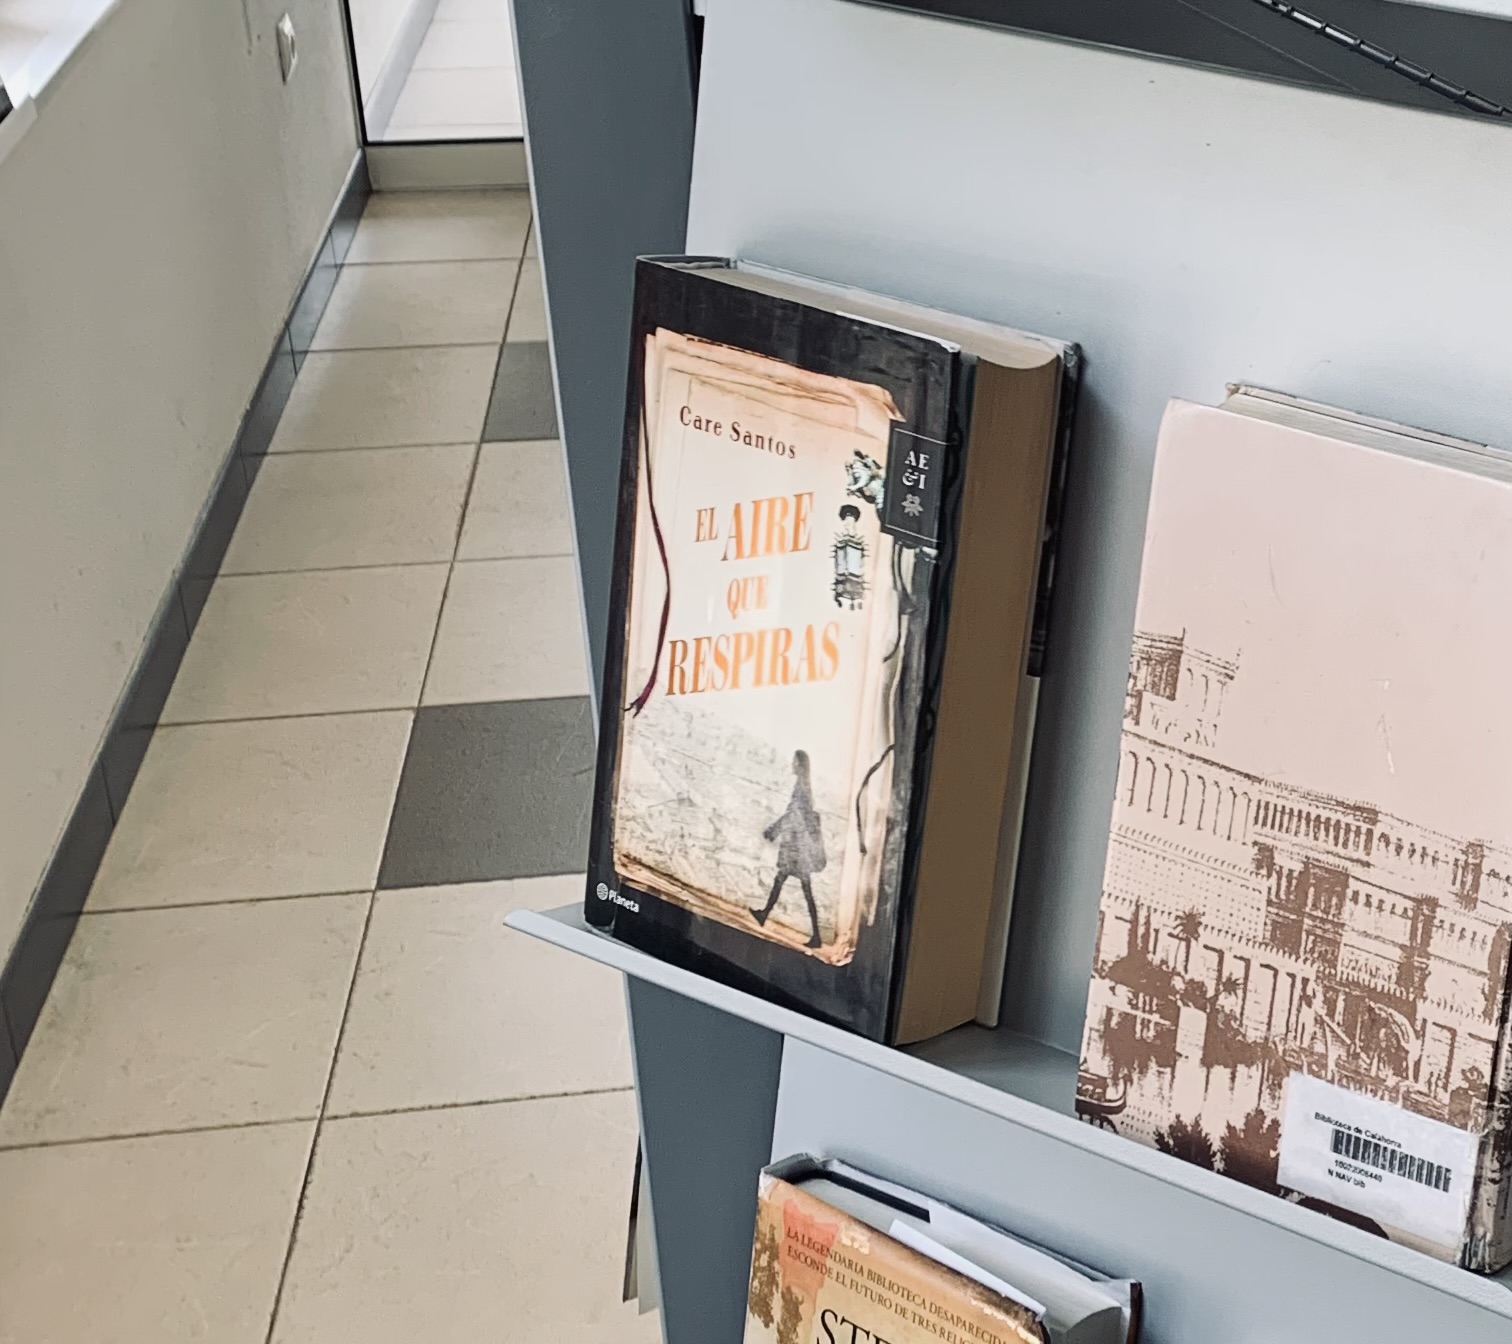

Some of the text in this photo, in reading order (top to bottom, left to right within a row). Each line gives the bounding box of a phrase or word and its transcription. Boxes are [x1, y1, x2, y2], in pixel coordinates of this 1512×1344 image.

[680, 405, 797, 459] Care Santos
[904, 450, 930, 470] AE
[694, 491, 814, 562] EL AIRE
[726, 574, 769, 620] QUE
[665, 621, 840, 697] RESPIRAS
[608, 889, 640, 914] Planeta
[1314, 1111, 1353, 1133] Biblioteca
[786, 1226, 800, 1240] LA
[801, 1235, 865, 1278] LEGENDARIA
[866, 1268, 927, 1310] BIBLIOTECA
[787, 1244, 835, 1279] ESCONDE
[835, 1271, 848, 1287] EL
[849, 1278, 893, 1311] FUTURO
[893, 1303, 910, 1322] DE
[910, 1311, 937, 1334] TRES
